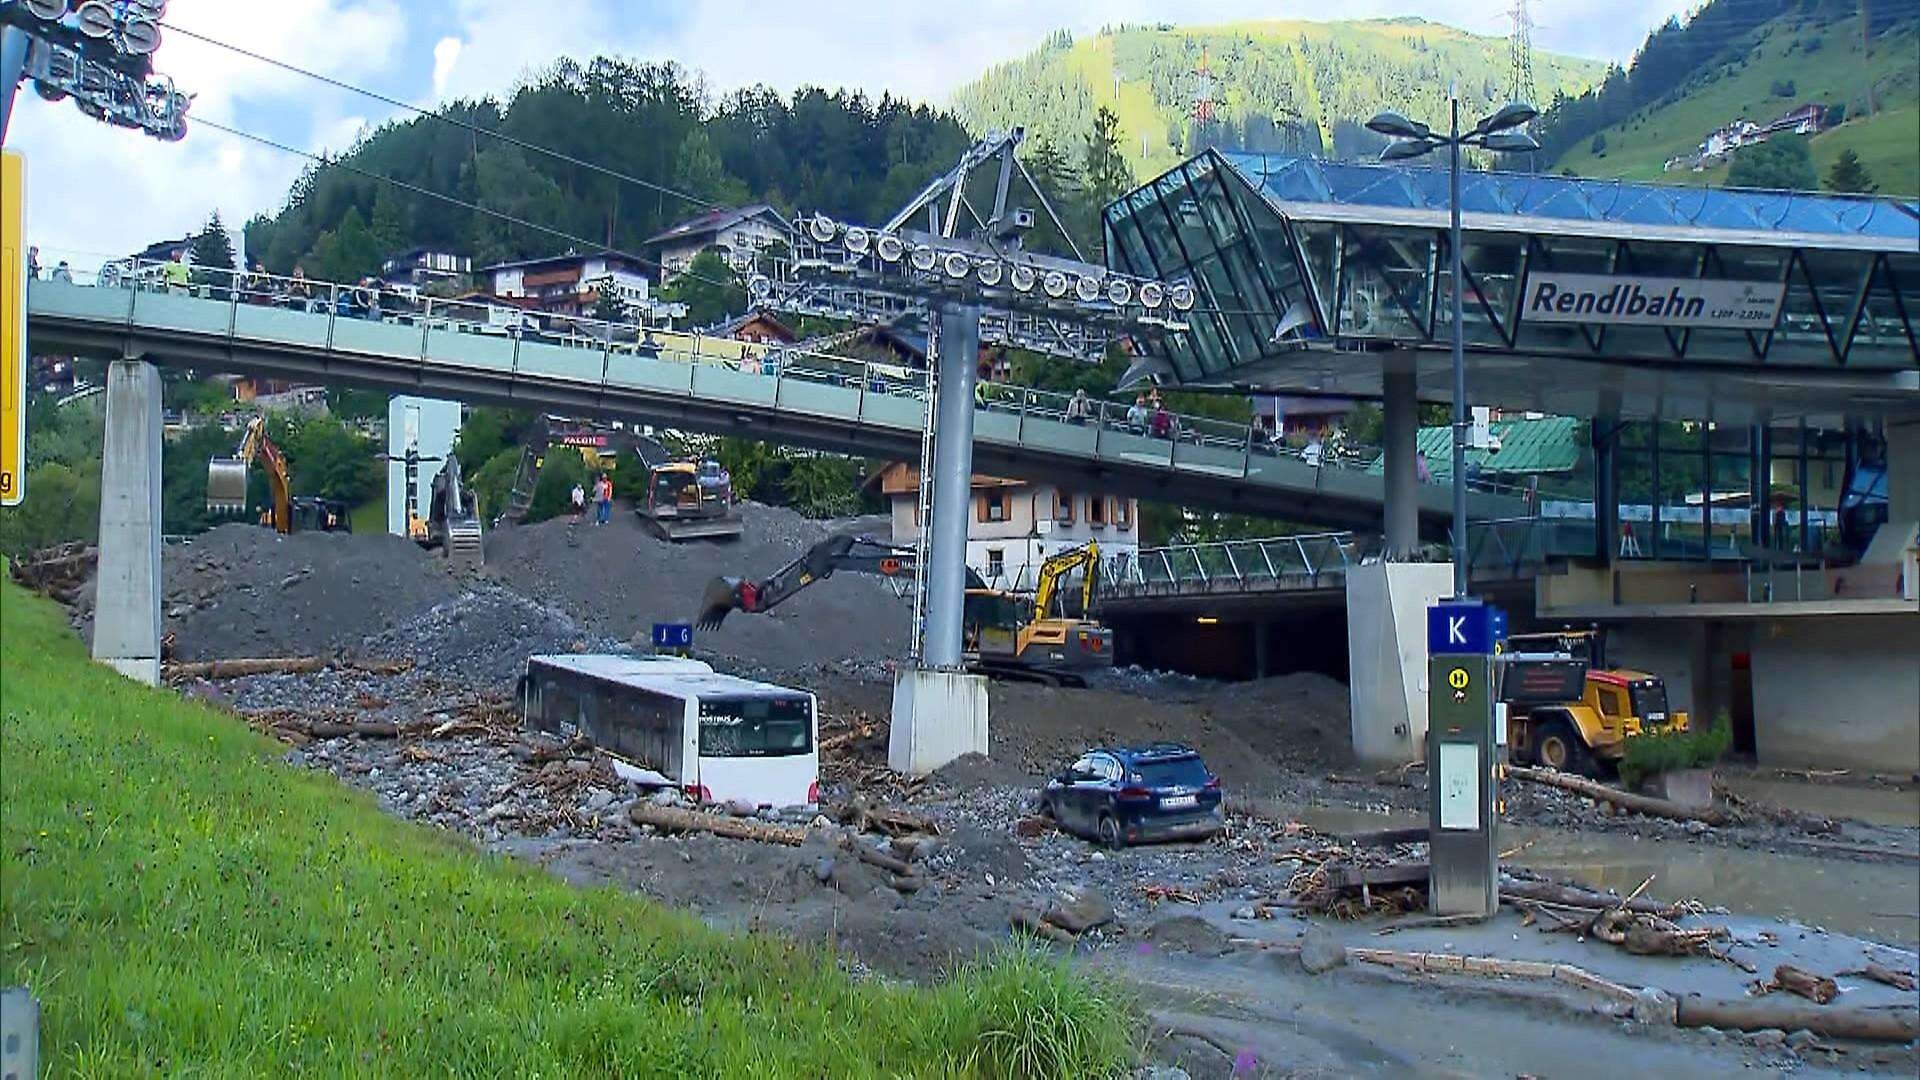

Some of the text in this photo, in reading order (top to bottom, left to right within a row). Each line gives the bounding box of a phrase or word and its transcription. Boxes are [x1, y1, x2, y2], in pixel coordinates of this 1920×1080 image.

[1531, 282, 1705, 318] Rendlbahn
[661, 628, 688, 642] J G
[1449, 616, 1467, 644] K
[1453, 673, 1464, 685] H
